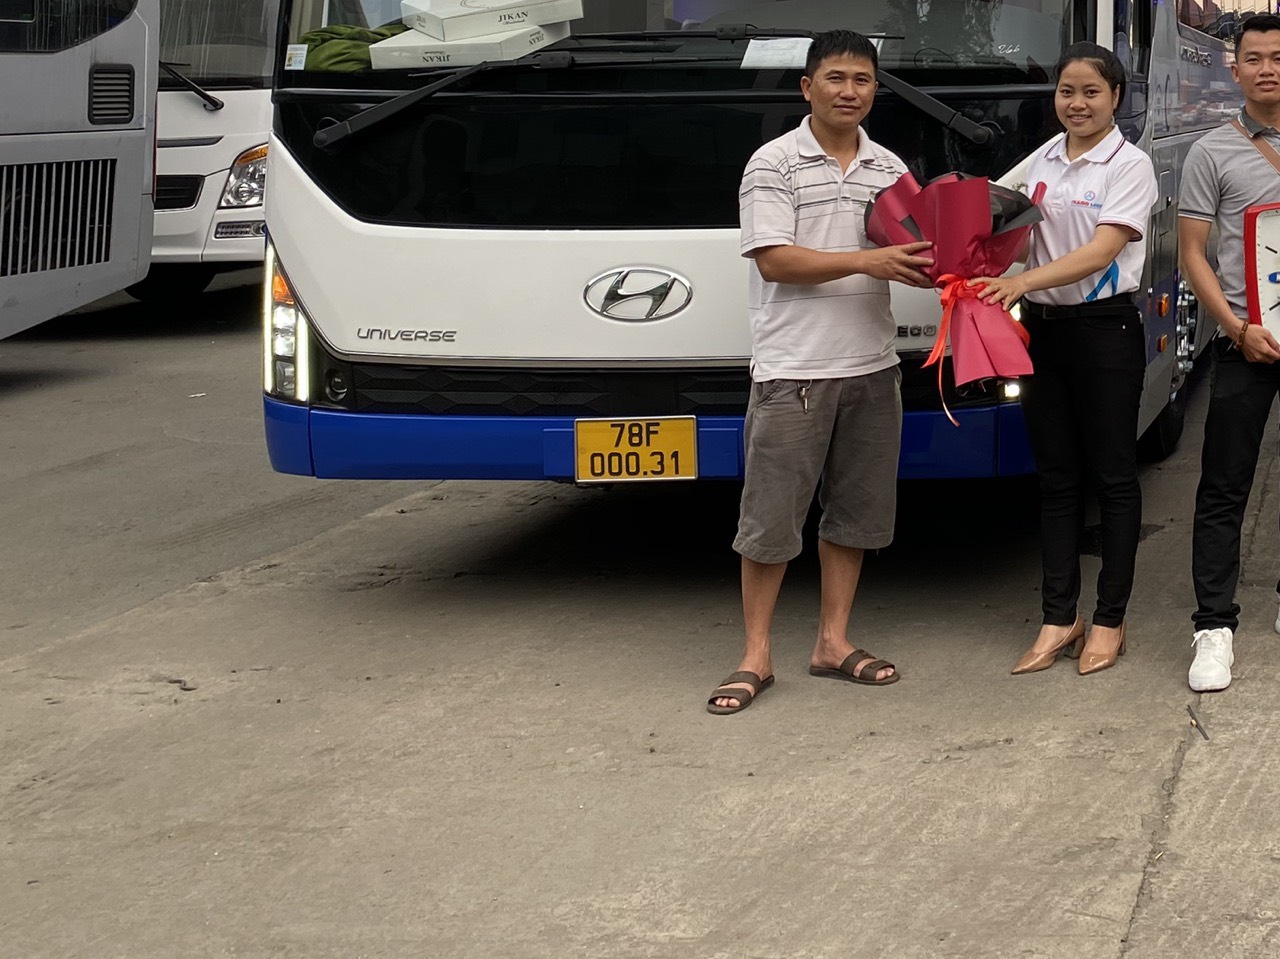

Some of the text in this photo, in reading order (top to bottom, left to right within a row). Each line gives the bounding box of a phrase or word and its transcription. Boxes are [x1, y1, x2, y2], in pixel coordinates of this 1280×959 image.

[497, 11, 528, 22] JIKAN
[356, 327, 458, 343] UNIVERSE
[610, 422, 661, 448] 78F
[589, 450, 680, 477] 000.31
